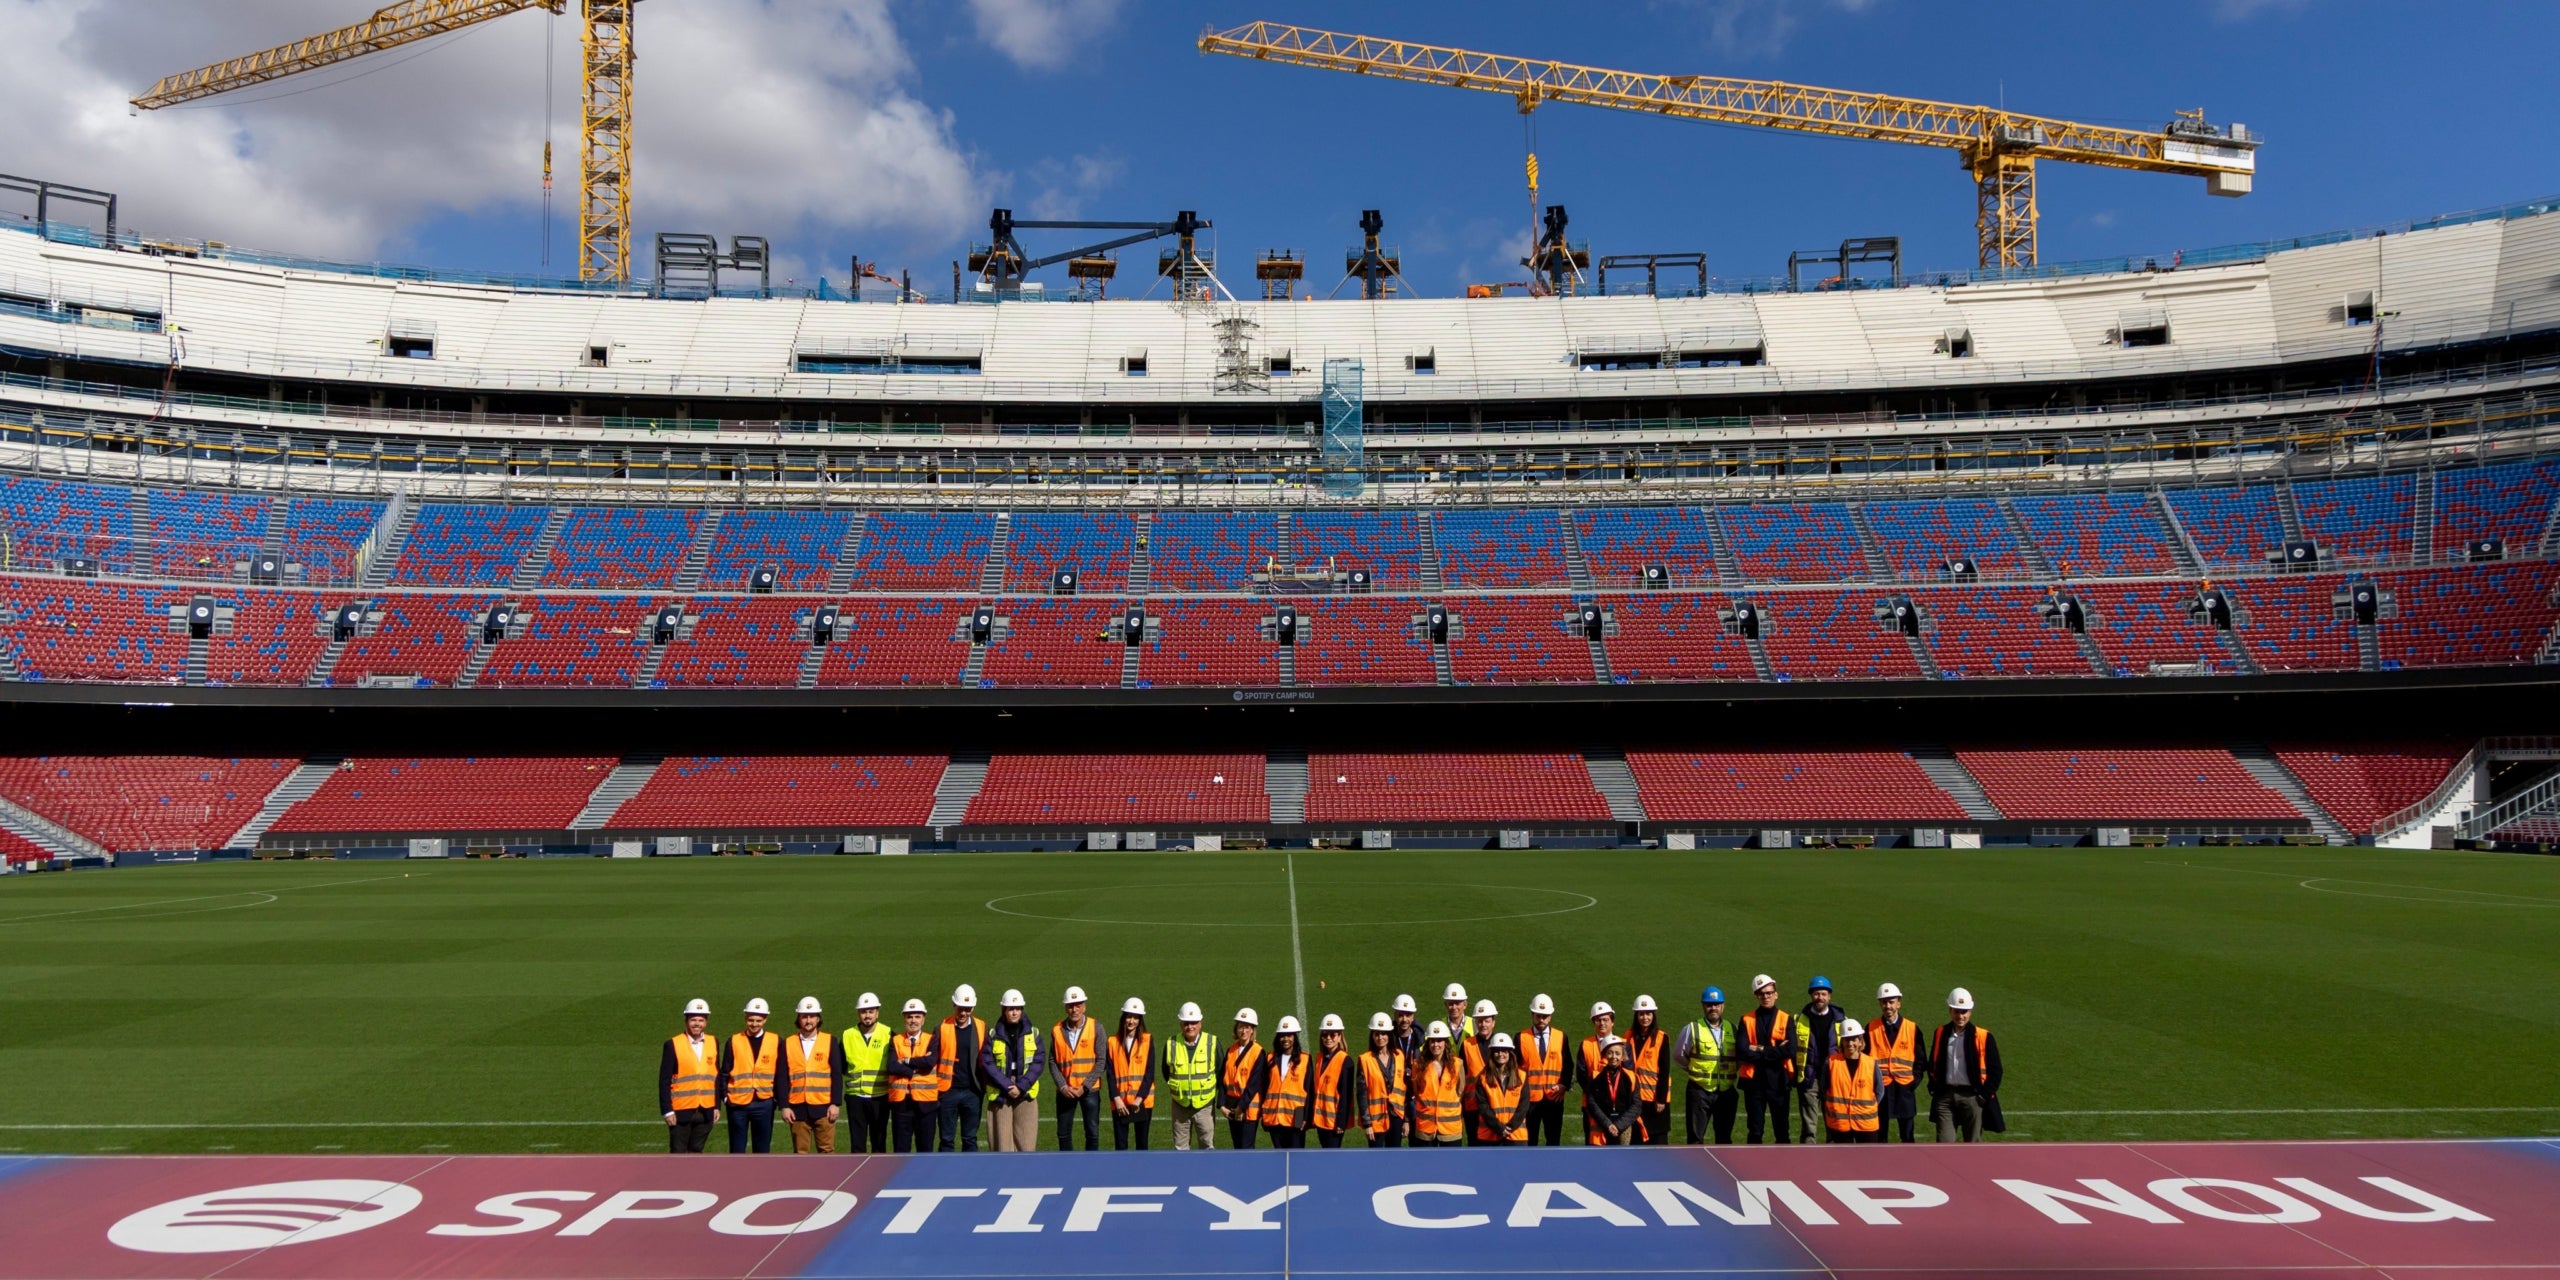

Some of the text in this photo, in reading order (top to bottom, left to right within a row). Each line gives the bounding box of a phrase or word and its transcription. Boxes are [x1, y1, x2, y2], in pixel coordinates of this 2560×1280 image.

[1244, 691, 1315, 700] SPOTIFY CAMP NOU
[426, 1176, 2495, 1237] SPOTIFY CAMP NOU
